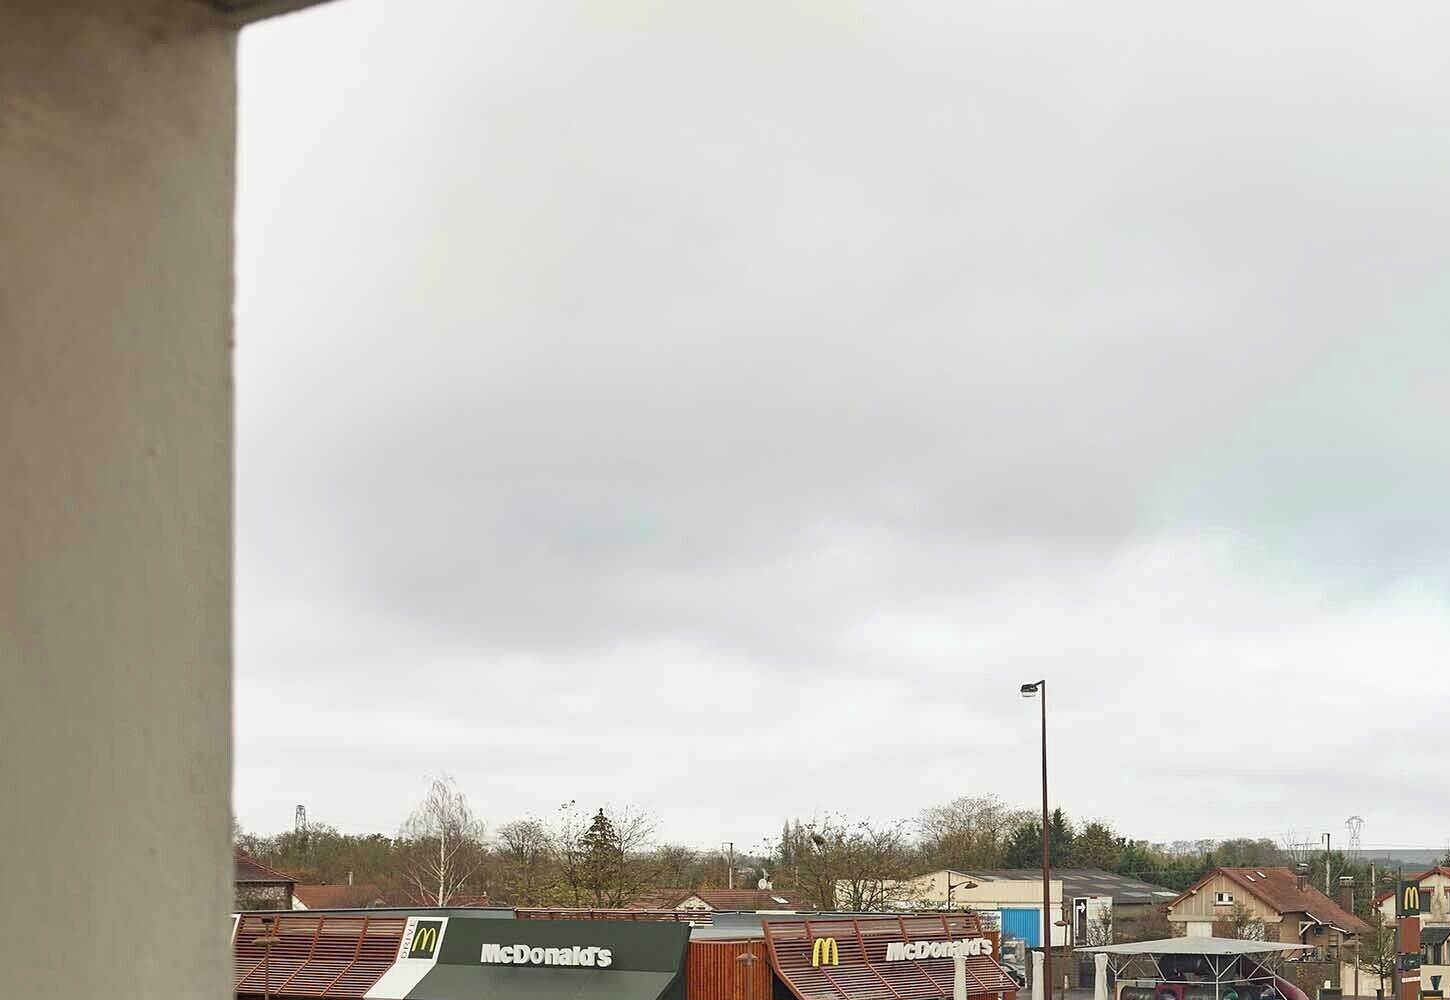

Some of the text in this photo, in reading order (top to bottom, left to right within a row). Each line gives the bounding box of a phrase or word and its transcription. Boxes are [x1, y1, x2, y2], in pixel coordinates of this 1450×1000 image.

[401, 919, 416, 959] DRIVE
[886, 937, 993, 962] McDonald's
[480, 943, 612, 967] McDonald's
